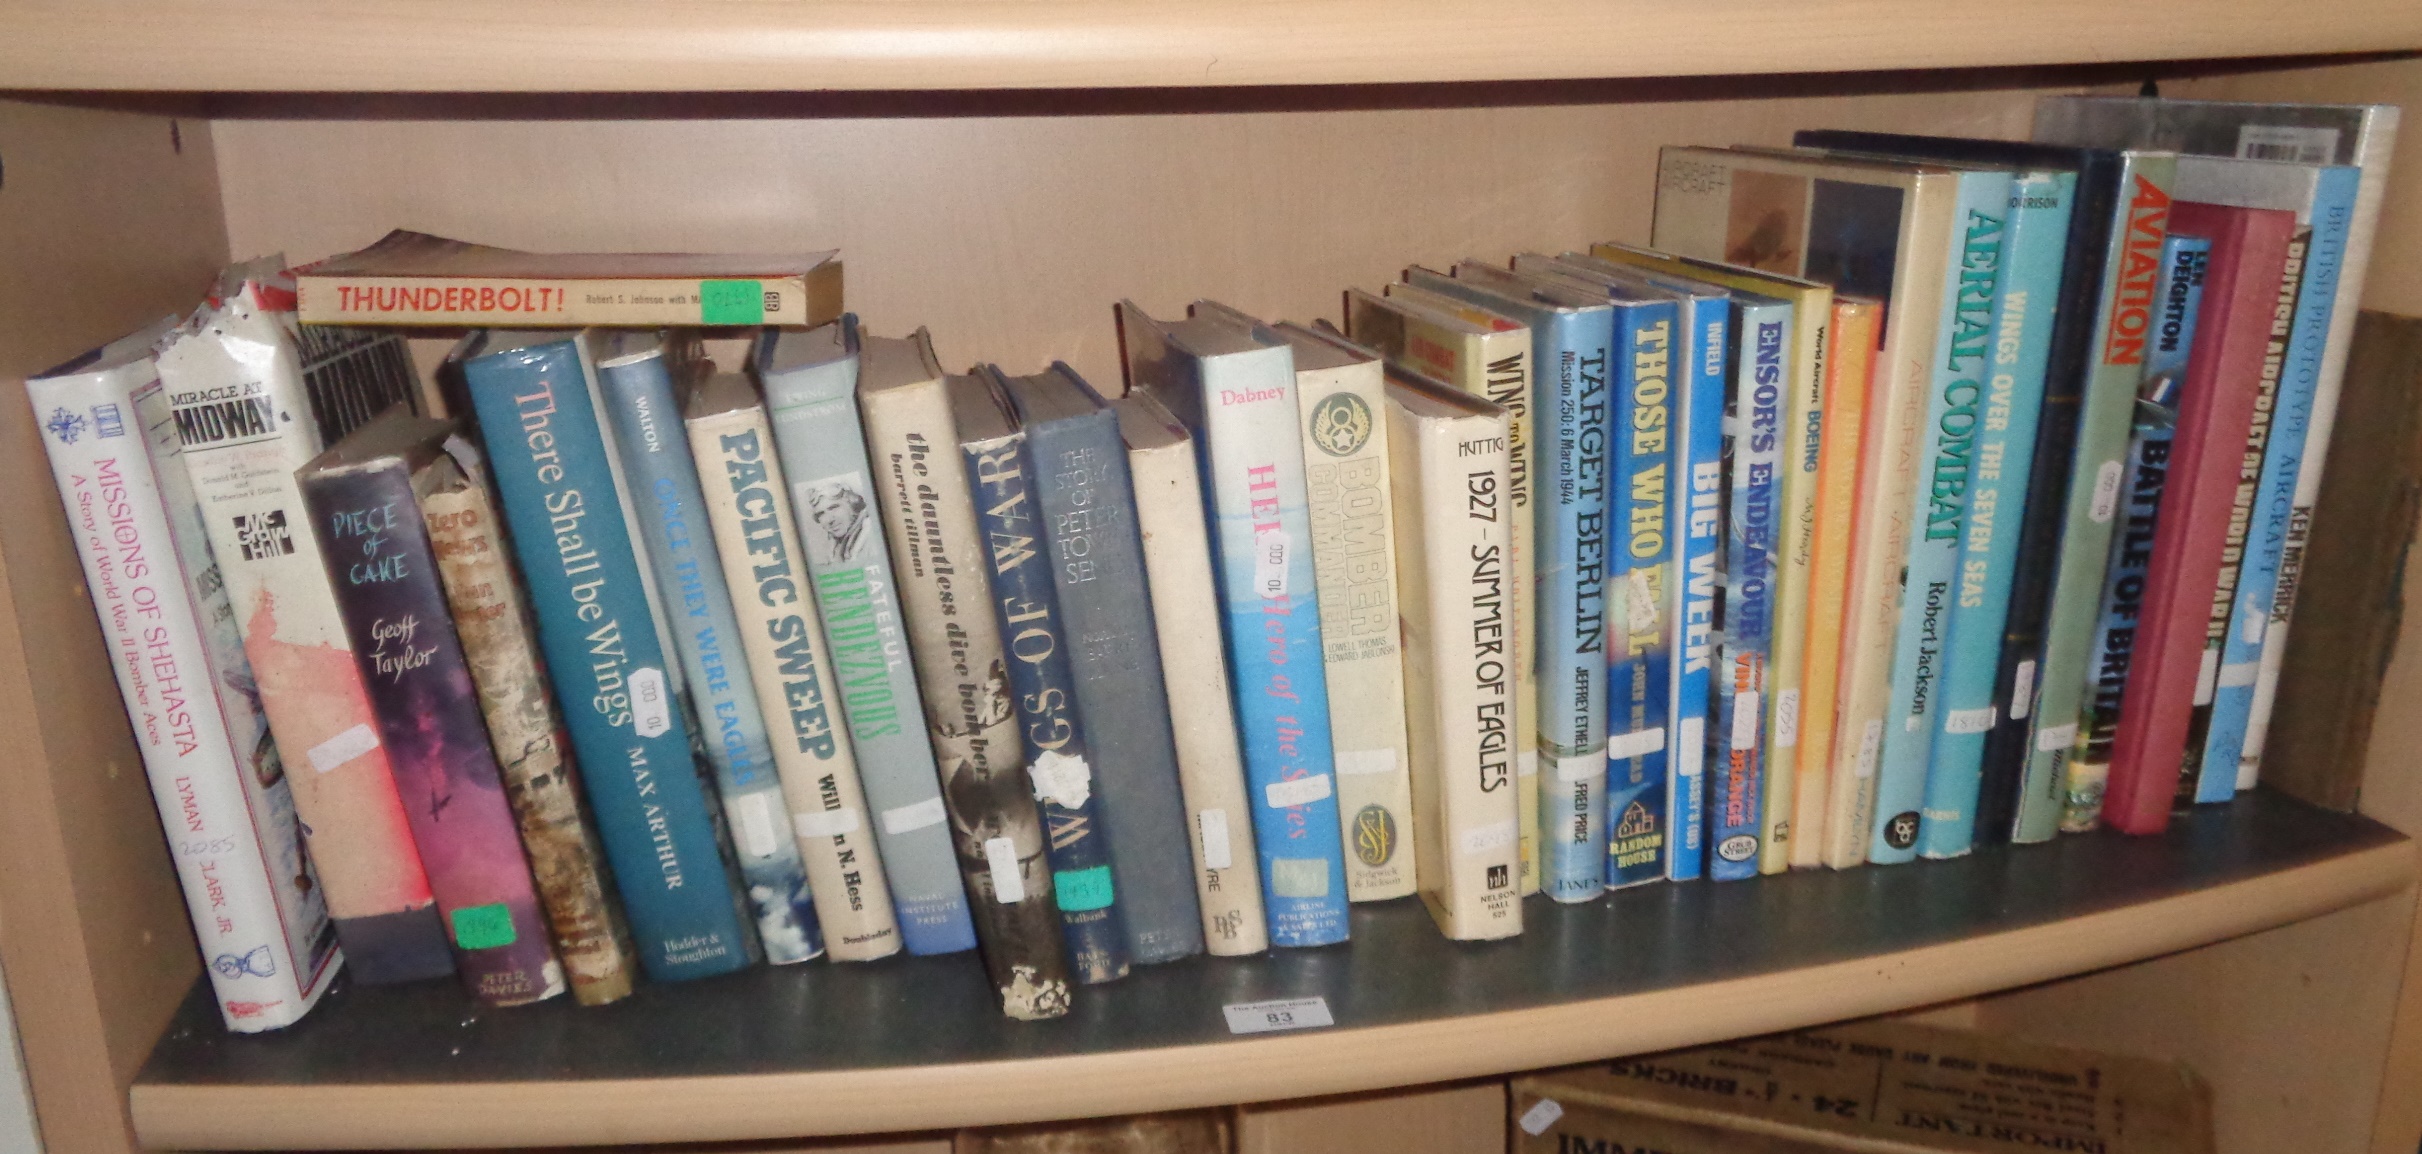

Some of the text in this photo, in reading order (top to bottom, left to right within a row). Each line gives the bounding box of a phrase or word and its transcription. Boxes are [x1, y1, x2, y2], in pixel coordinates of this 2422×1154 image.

[2110, 172, 2173, 366] AVIATION
[2313, 206, 2345, 296] BRITISH
[337, 286, 565, 313] THUNDERBOLT!
[586, 294, 614, 305] Robert
[668, 294, 687, 305] with
[2159, 250, 2194, 352] DEIGHTON
[1705, 321, 1724, 377] INFIELD
[1811, 326, 1825, 405] World Aircraft
[1924, 208, 2006, 549] AERIAL COMBAT
[171, 381, 262, 407] MIRACLE AT
[172, 395, 277, 446] MIDWAY
[1221, 386, 1286, 407] Dabney
[1750, 320, 1783, 454] ENSOR'S
[635, 395, 661, 453] WALTON
[1459, 437, 1505, 458] HUTTIG
[1560, 350, 1576, 506] Mission 250: March 1944
[1630, 320, 1670, 560] THOSE WHO
[1803, 409, 1823, 474] BOEING
[1959, 291, 2028, 609] WINGS OVER THE SEVEN SEAS
[94, 458, 149, 579] MISSIONS
[331, 503, 399, 539] PIECE
[890, 453, 925, 578] barrett tillman
[976, 441, 1038, 577] WAR
[1468, 470, 1498, 524] 1927
[1574, 347, 1607, 655] TARGET BERLIN
[2110, 439, 2173, 621] BATTLE OF
[2259, 453, 2297, 573] AIRCRAFT
[350, 553, 410, 585] CAKE
[362, 537, 389, 560] of
[515, 379, 633, 728] There Shall be Wings
[1309, 463, 1349, 640] COMMANDER
[1338, 456, 1392, 637] BOMBER
[1684, 461, 1723, 675] BIG WEEK
[1738, 461, 1773, 641] ENDEAVOUR
[71, 473, 162, 747] A Story of World War II Bomber Aces
[132, 586, 161, 620] OF
[719, 427, 837, 762] PACIFIC SWEEP
[864, 564, 903, 674] FATEFUL
[906, 432, 991, 783] the dauntless dive bomber
[1471, 545, 1504, 660] SUMMER
[371, 613, 420, 651] Geoff
[653, 477, 756, 786] ONCE THEY WERE EAGLES
[815, 567, 902, 743] RENDEZVOUS
[1003, 597, 1056, 664] OF
[1910, 581, 1948, 716] Robert Jackson
[143, 625, 200, 758] SHEHASTA
[370, 646, 439, 684] Taylor
[1476, 660, 1505, 696] OF
[1575, 666, 1589, 718] JEFFREY
[1262, 594, 1314, 840] Hero of the Sies
[1477, 701, 1508, 794] EAGLES
[1023, 688, 1092, 852] WGS
[1726, 749, 1748, 827] ORANGE
[175, 776, 204, 832] LYMAN
[627, 746, 685, 890] MAX ARTHUR
[1574, 814, 1589, 845] PRICE
[1356, 867, 1398, 879] Sidgwick
[1609, 834, 1663, 856] RANDOM
[1617, 850, 1657, 870] HOUSE
[837, 848, 863, 912] N. Hess
[1364, 875, 1401, 888] Jackson
[1480, 891, 1517, 903] NELSON
[1487, 901, 1510, 911] HALL
[216, 916, 233, 935] JR
[664, 935, 709, 953] Hodder
[843, 927, 893, 946] Doubleday
[916, 915, 949, 926] PRESS
[665, 946, 728, 966] Stoughton
[1252, 1002, 1287, 1011] Auction
[1266, 1012, 1294, 1024] 83
